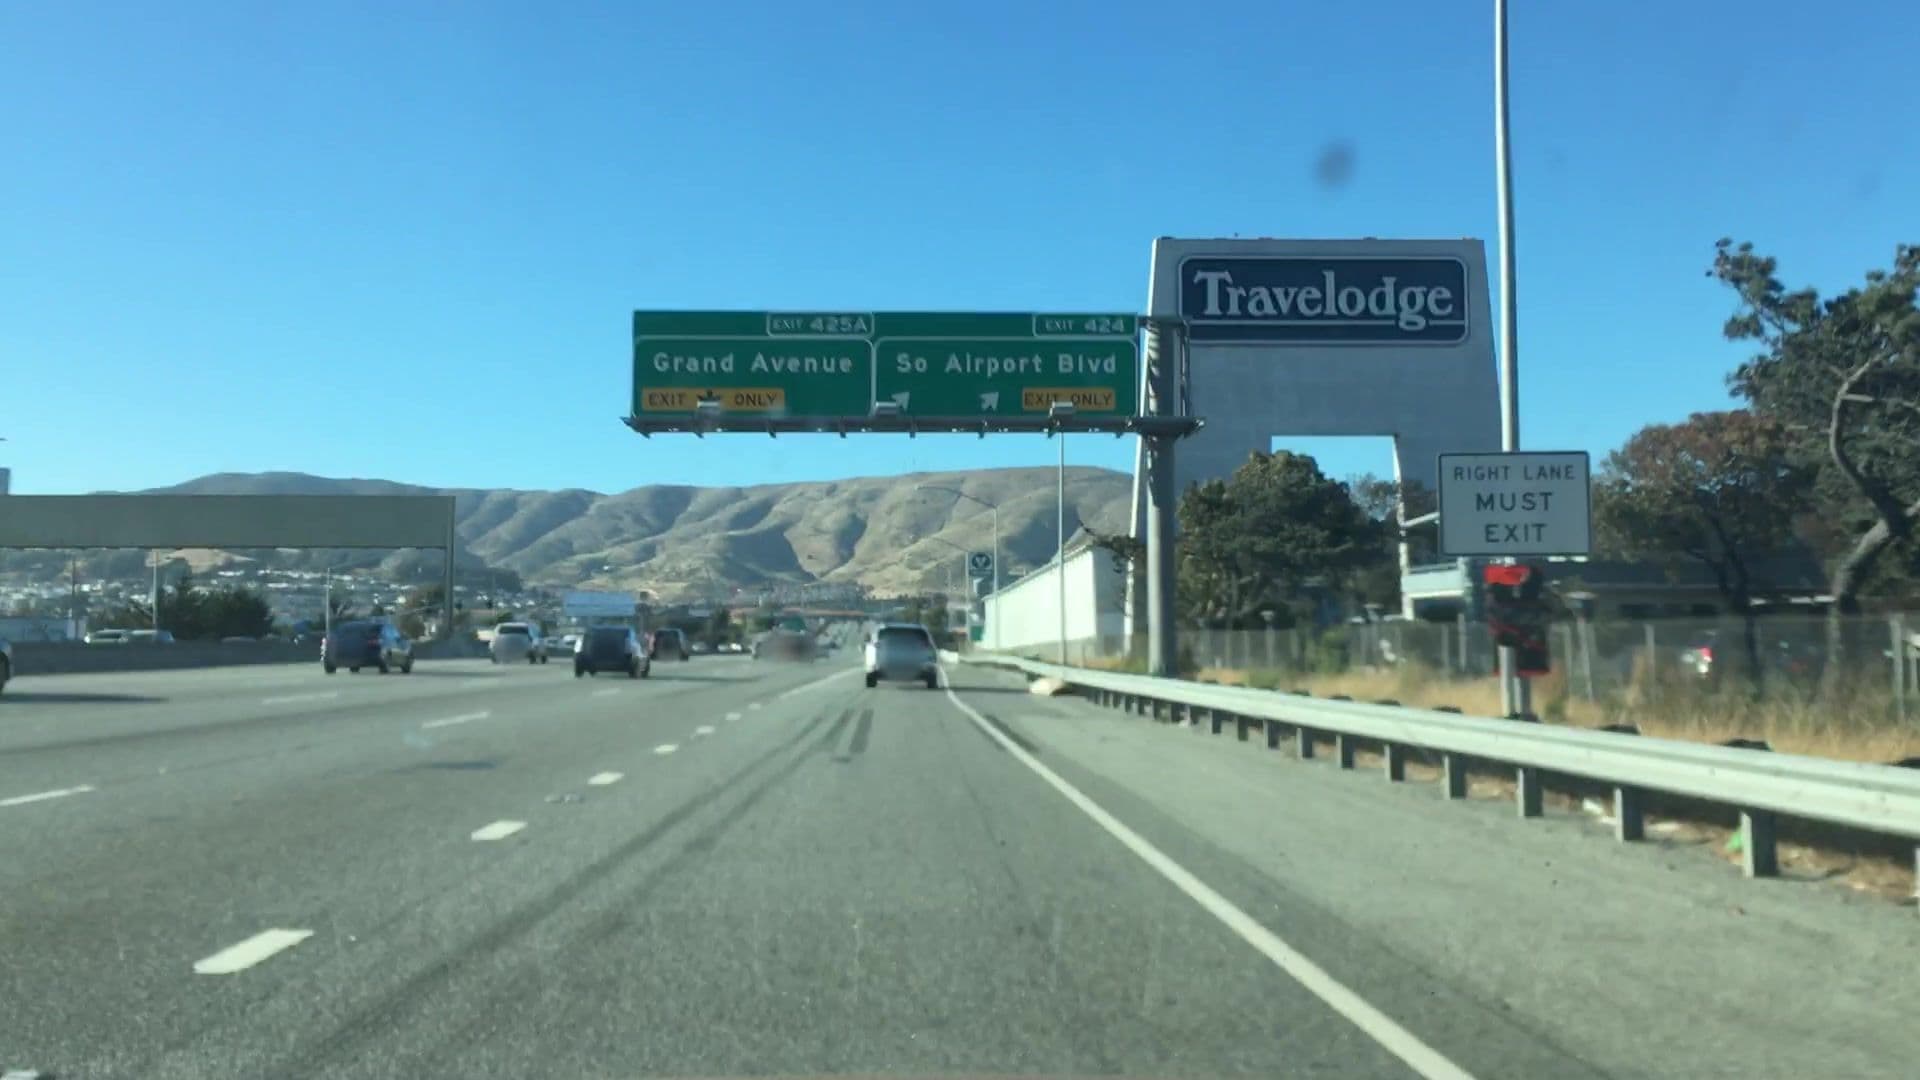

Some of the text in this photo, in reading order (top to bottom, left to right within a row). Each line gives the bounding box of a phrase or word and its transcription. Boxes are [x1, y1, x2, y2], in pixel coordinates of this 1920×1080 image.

[1193, 269, 1453, 331] Travelodge
[772, 316, 868, 333] EXIT 425A
[1045, 318, 1125, 333] EXIT 424
[653, 352, 853, 373] Grand Avenue
[896, 353, 1116, 378] So Airport Blvd
[648, 392, 777, 407] EXIT ONLY
[1071, 391, 1112, 408] ONLY
[1454, 465, 1576, 480] RIGHT LANE
[1476, 492, 1553, 512] MUST
[1485, 523, 1547, 543] EXIT
